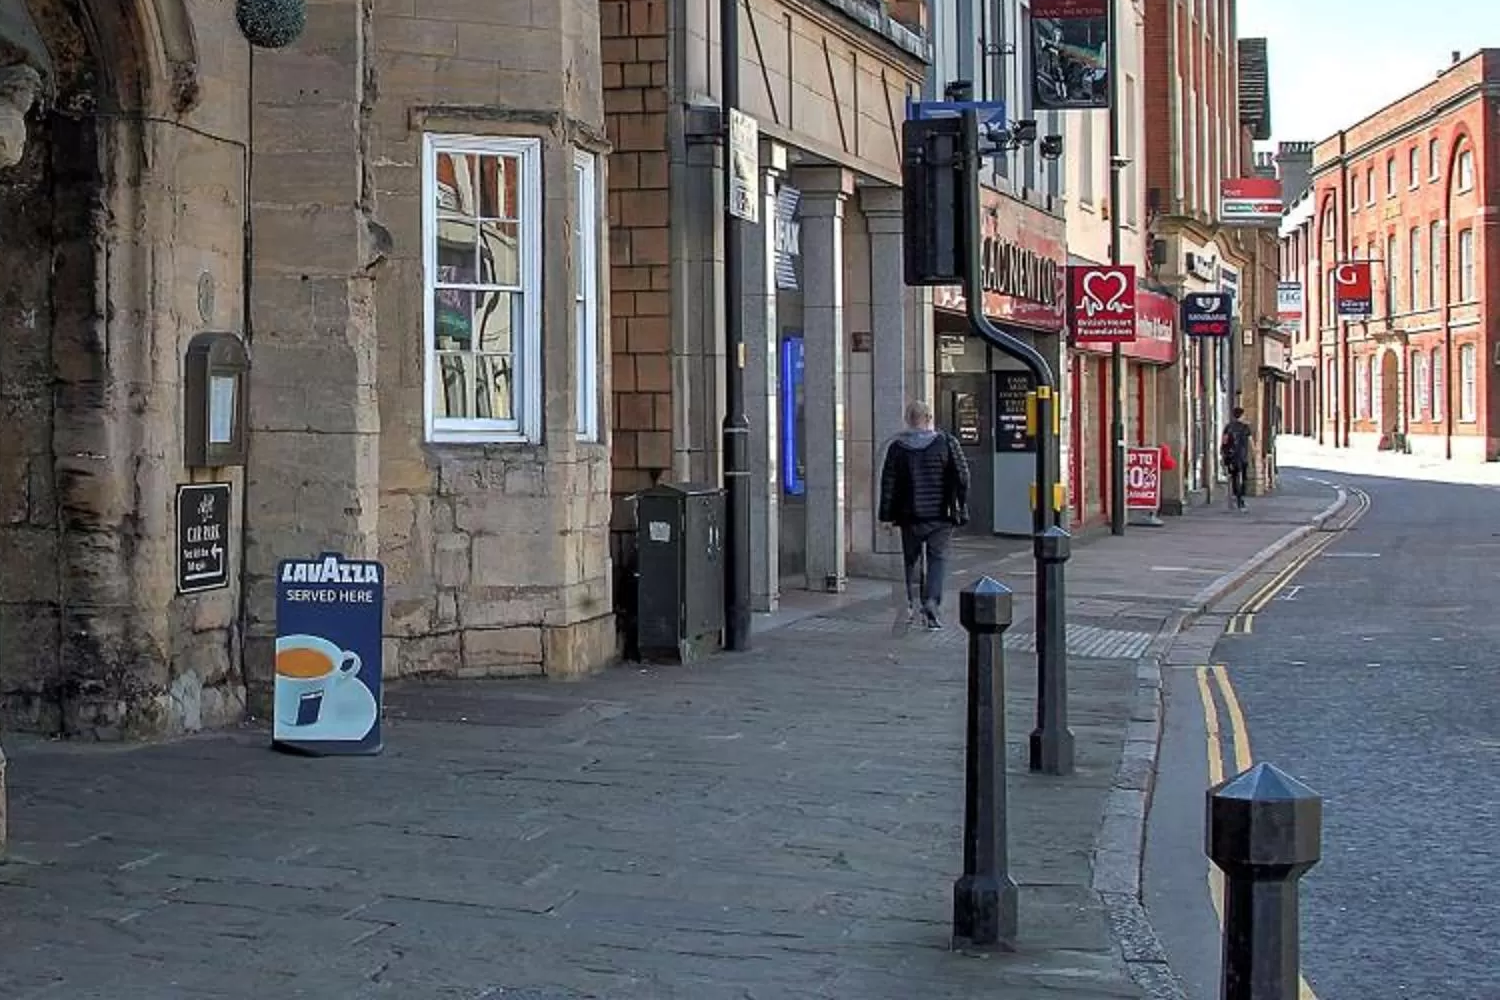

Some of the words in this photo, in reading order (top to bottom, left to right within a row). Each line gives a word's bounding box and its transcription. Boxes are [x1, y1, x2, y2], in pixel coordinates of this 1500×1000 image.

[1077, 327, 1133, 335] Foundation
[1138, 454, 1153, 465] TO
[187, 526, 202, 543] CAR
[203, 523, 221, 541] PARK
[281, 557, 380, 583] LAVAZZA
[286, 589, 337, 602] SERVED
[339, 589, 373, 603] HERE
